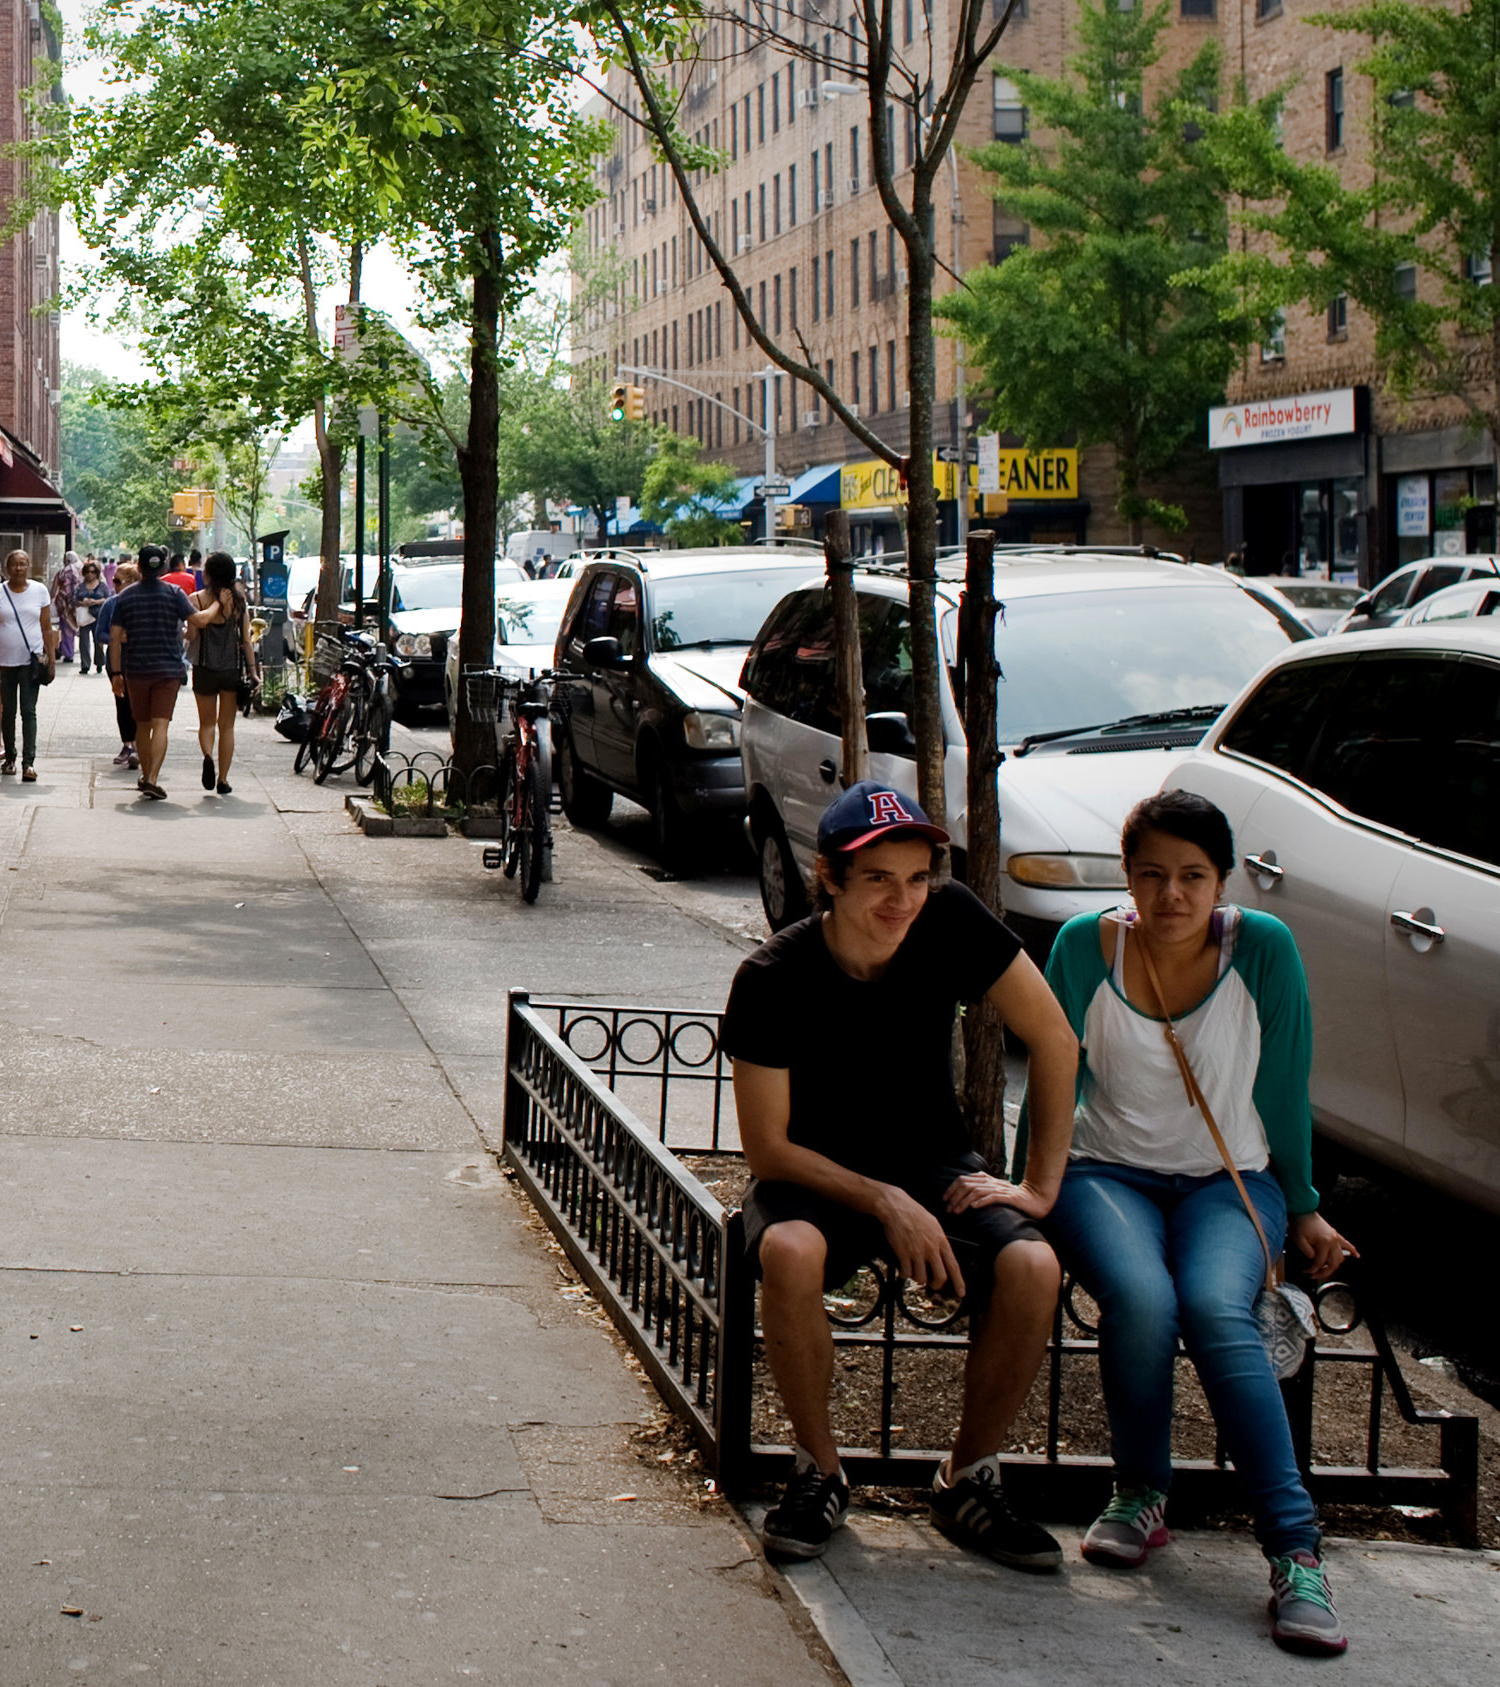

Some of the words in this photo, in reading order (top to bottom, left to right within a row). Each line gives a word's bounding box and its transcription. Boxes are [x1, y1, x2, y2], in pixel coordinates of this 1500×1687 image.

[1244, 399, 1332, 429] Rainbowberry
[270, 545, 281, 560] P
[867, 791, 913, 825] A
